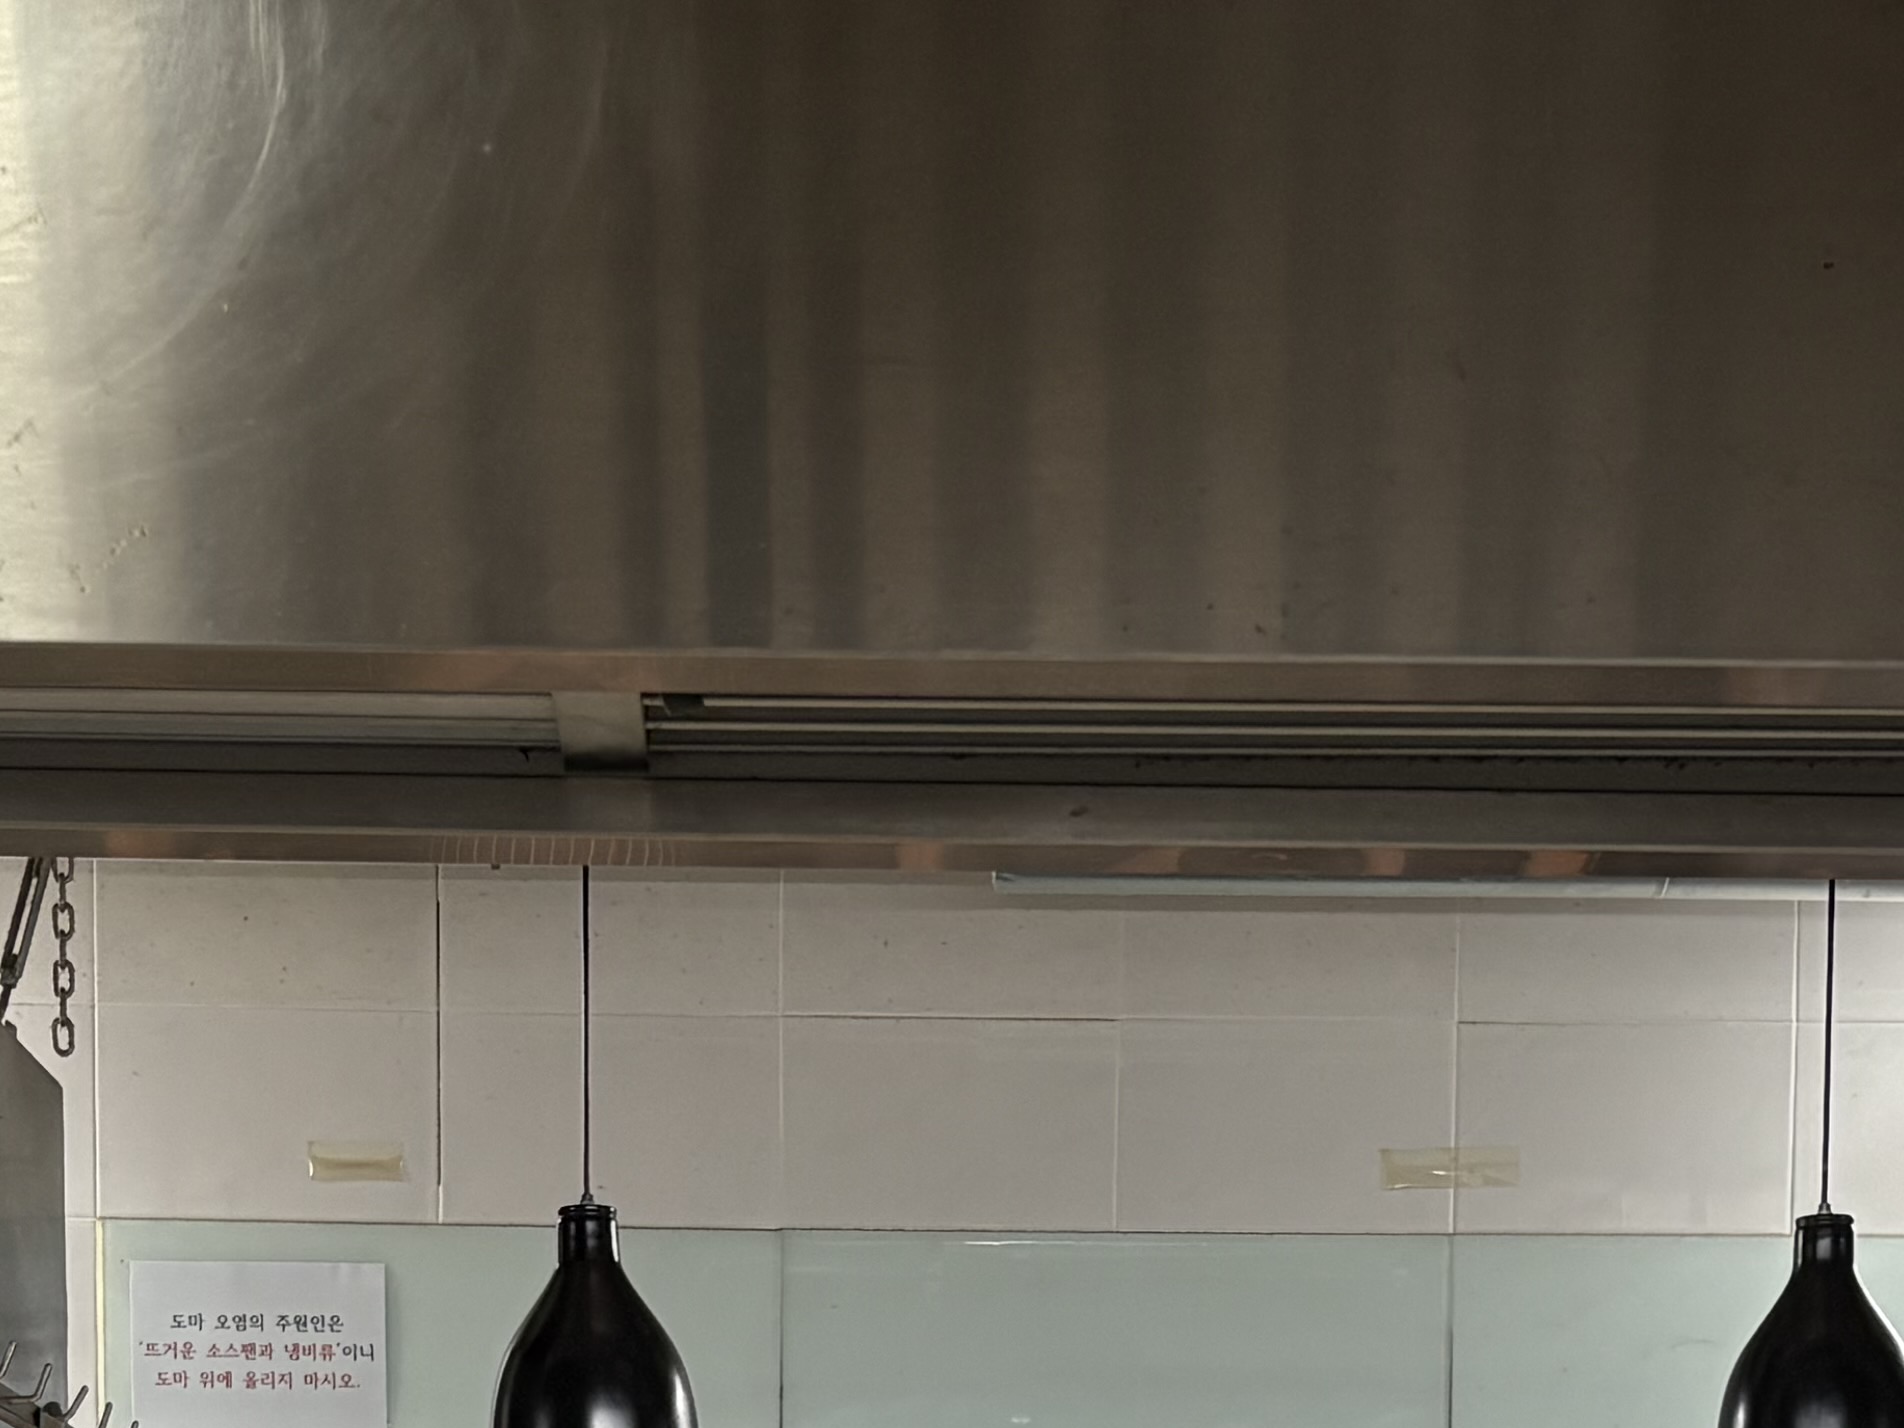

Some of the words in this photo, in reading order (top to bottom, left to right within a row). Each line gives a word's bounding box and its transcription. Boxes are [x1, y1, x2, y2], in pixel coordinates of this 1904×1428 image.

[170, 1313, 205, 1331] 도마
[214, 1313, 264, 1332] 오염의
[276, 1314, 344, 1333] 주원인은
[206, 1342, 273, 1361] 소스팬과
[155, 1370, 190, 1389] 도마
[200, 1371, 233, 1389] 위에
[243, 1371, 292, 1390] 올리지
[304, 1371, 360, 1390] 마시오.
